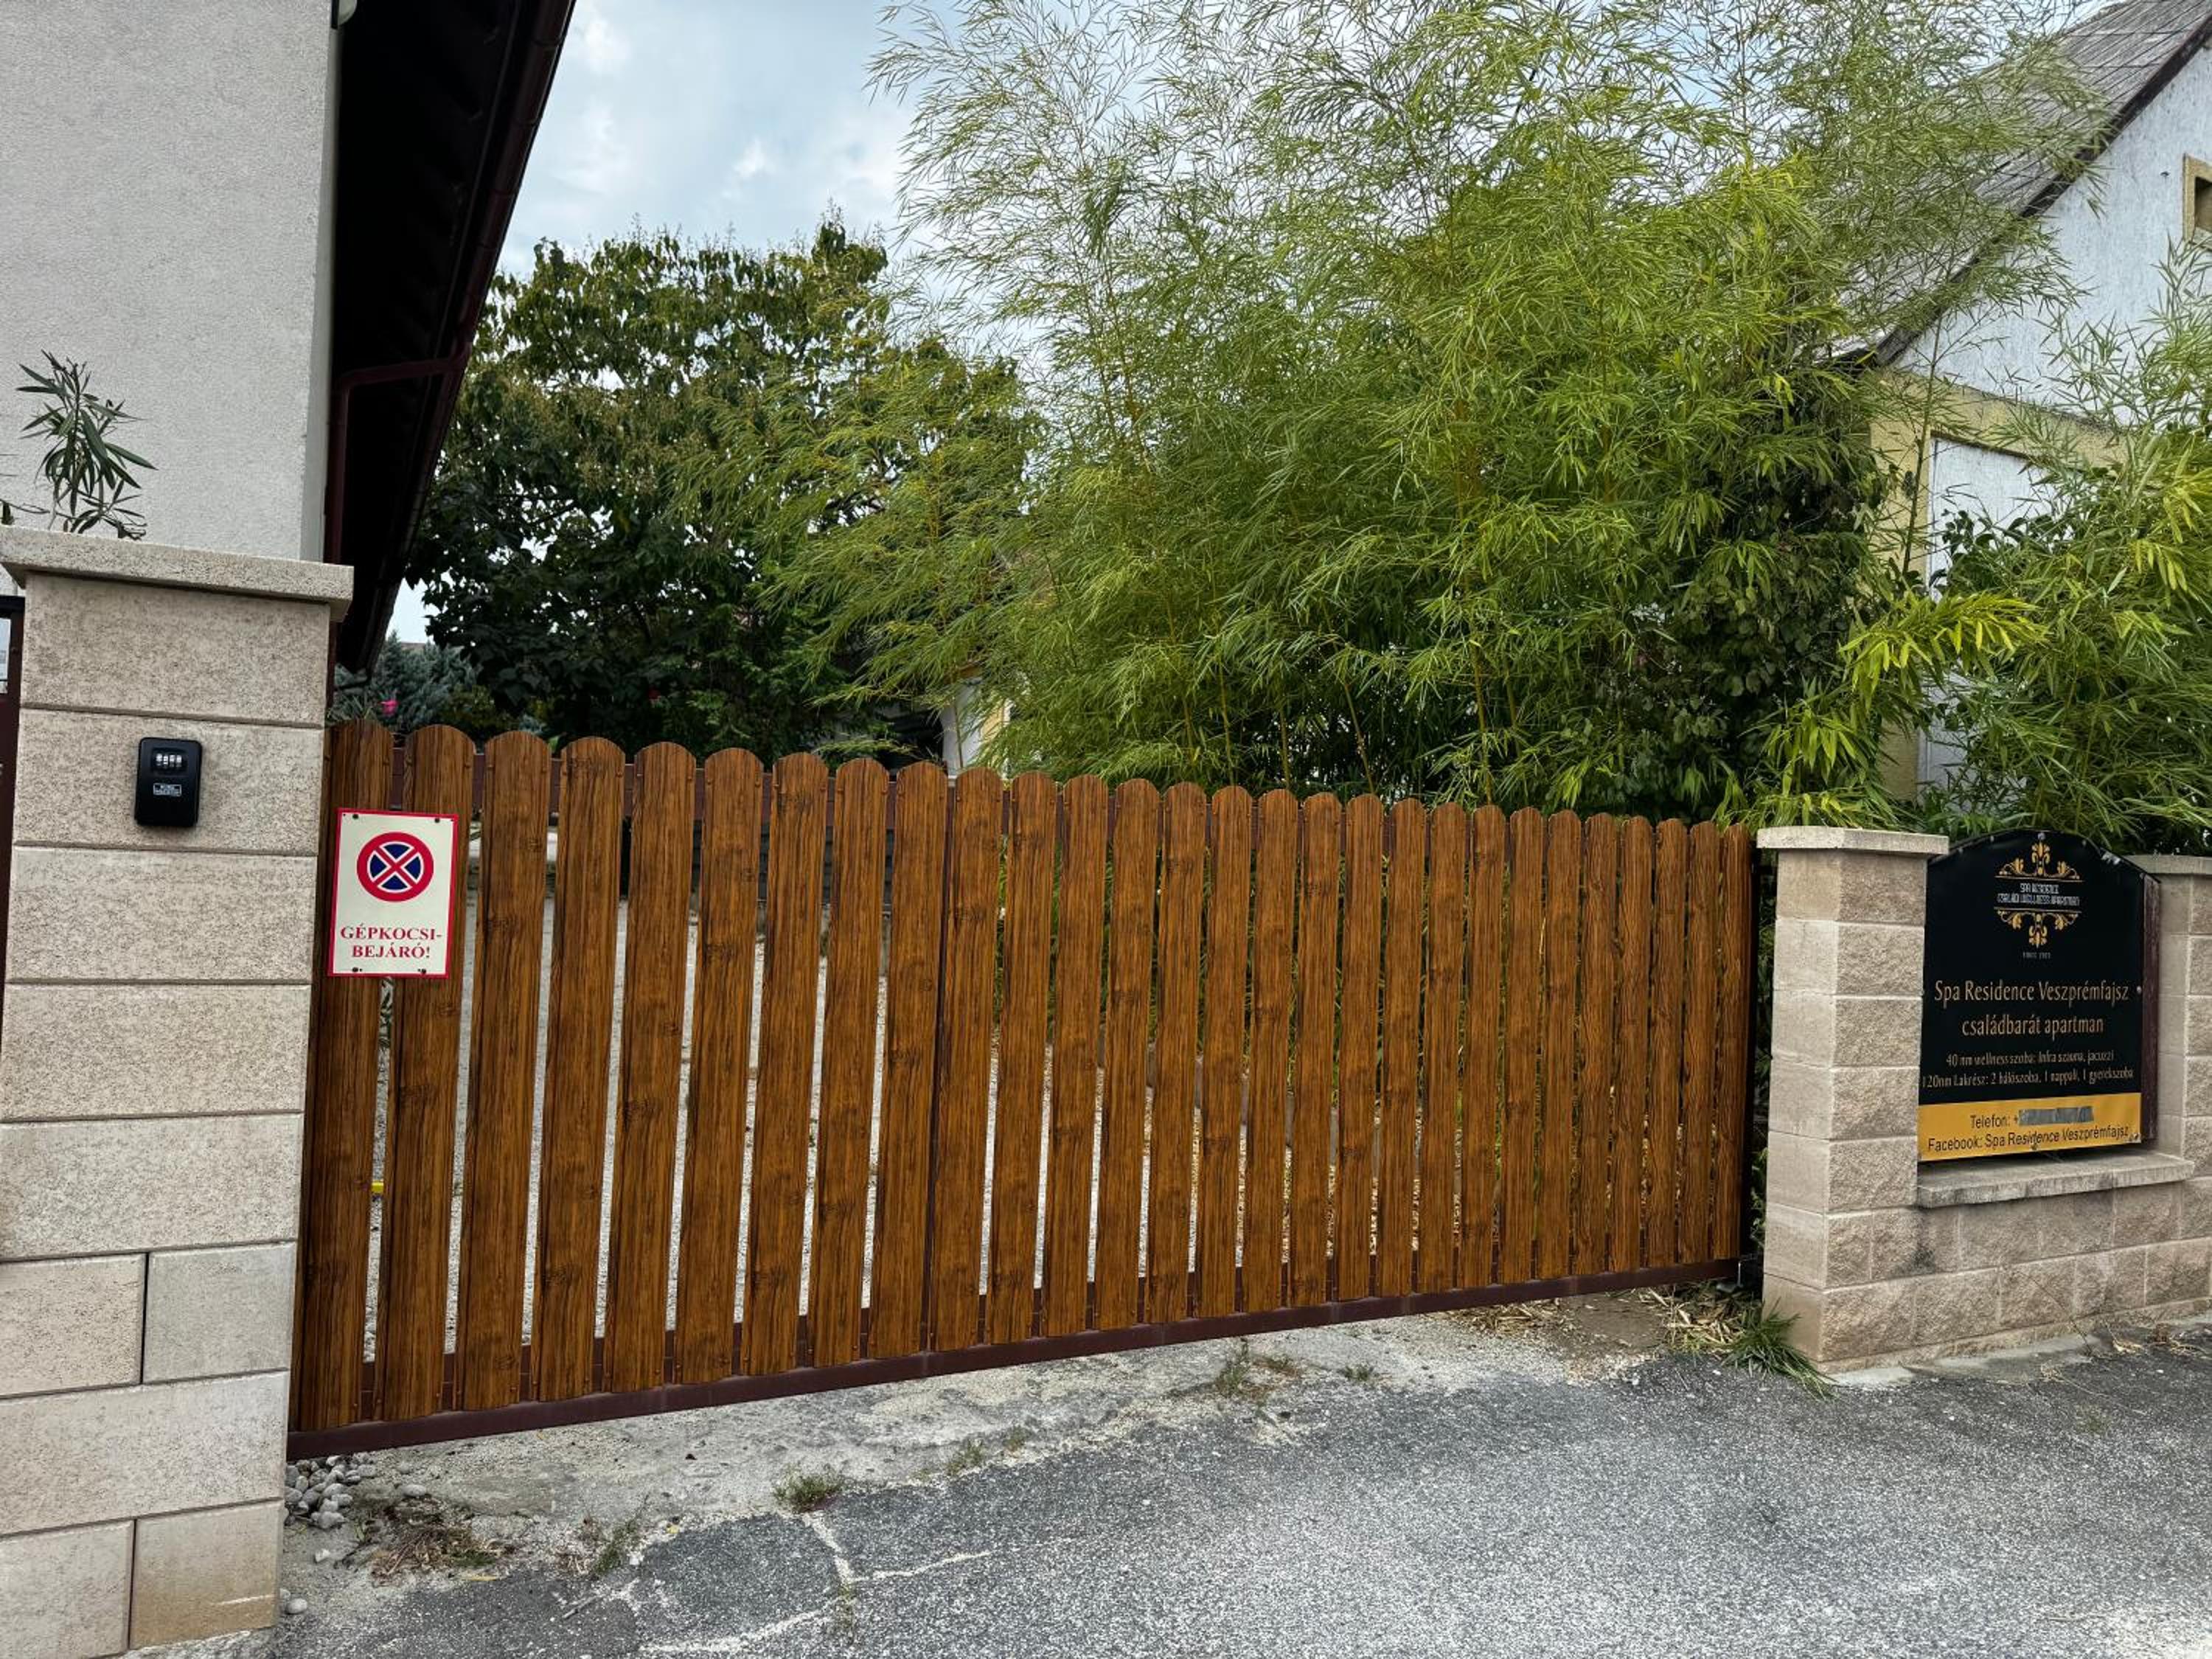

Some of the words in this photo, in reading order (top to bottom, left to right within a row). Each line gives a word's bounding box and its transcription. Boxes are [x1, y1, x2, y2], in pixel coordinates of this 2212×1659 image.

[340, 923, 442, 940] GÉPKOCSI-
[352, 942, 430, 959] BEJÁRÓ!
[1934, 980, 1961, 1009] Spa
[1965, 979, 2035, 1001] Residence
[2039, 980, 2129, 1008] Veszprémfajsz
[1962, 1014, 2041, 1036] családbarát
[2045, 1018, 2104, 1041] apartman
[1947, 1054, 1958, 1067] 40
[1975, 1051, 2009, 1065] wellness
[1991, 1072, 1997, 1085] 2
[1970, 1113, 2011, 1129] Telefon:
[1927, 1136, 1983, 1152] Facebook:
[1985, 1133, 2006, 1149] Spa
[2008, 1130, 2060, 1146] Residence
[2062, 1124, 2129, 1142] Veszprémfajsz
